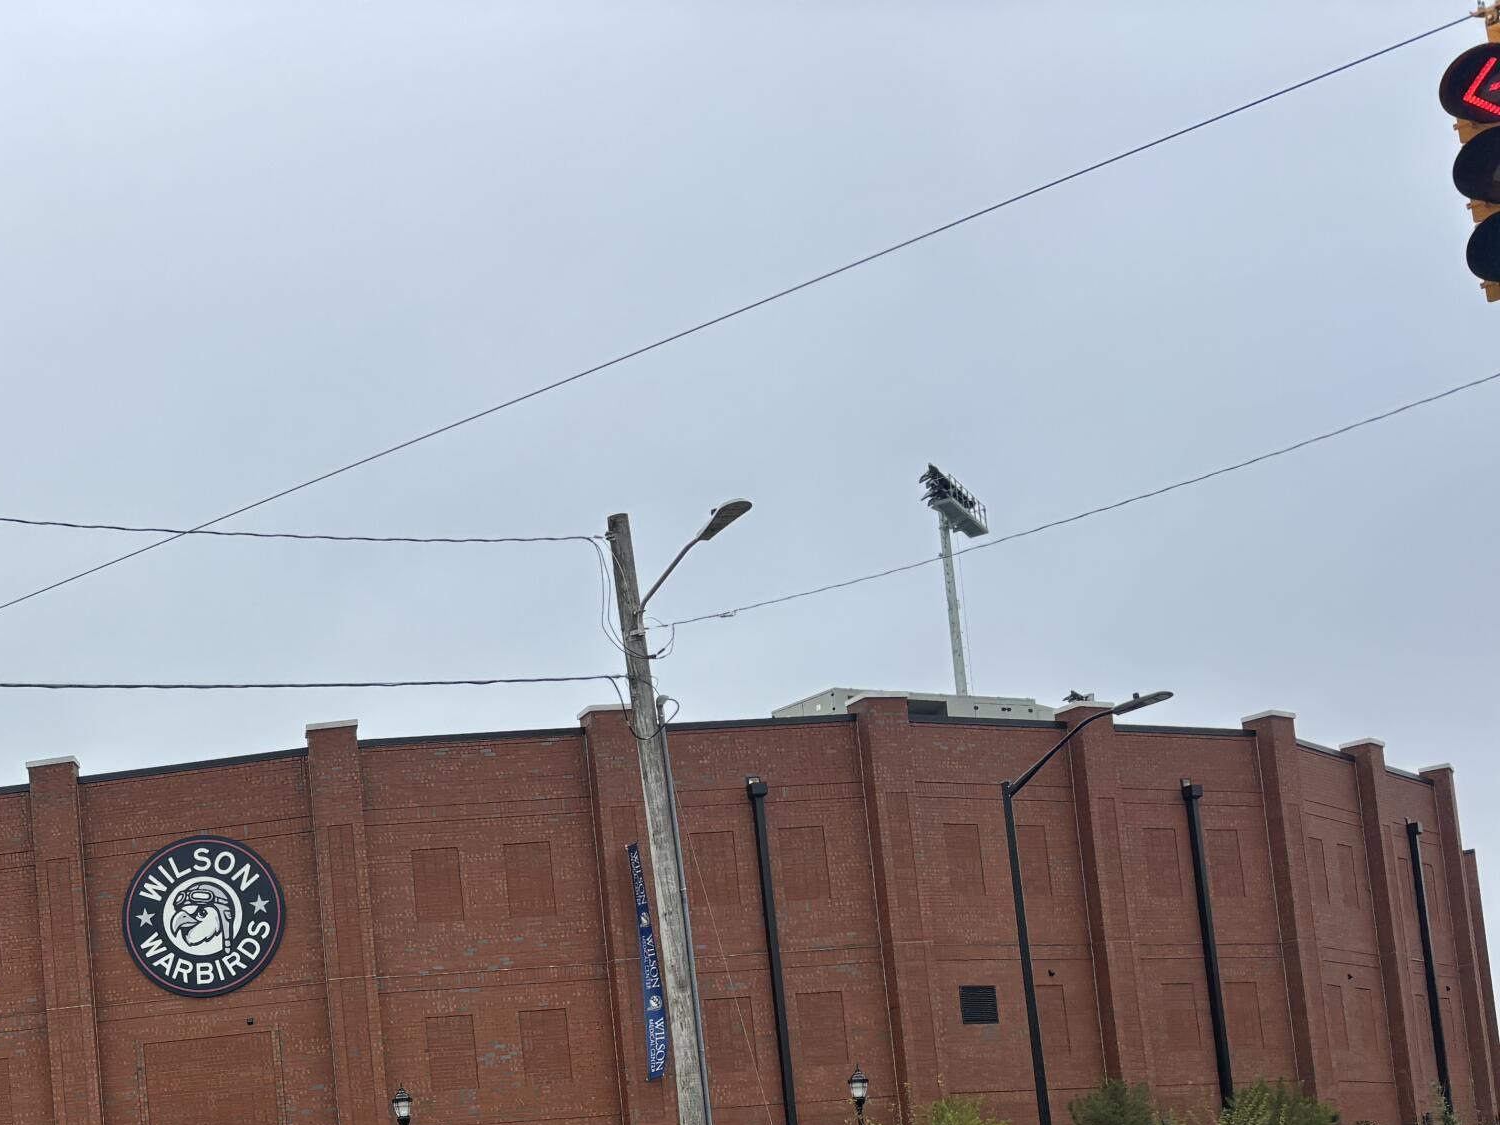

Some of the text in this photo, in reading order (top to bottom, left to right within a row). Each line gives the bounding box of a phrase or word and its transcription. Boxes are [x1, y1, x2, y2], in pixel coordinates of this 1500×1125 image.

[139, 847, 260, 902] WILSON
[140, 920, 271, 985] WARBIRDS
[646, 933, 660, 988] WILSON
[654, 1017, 666, 1072] WILSON
